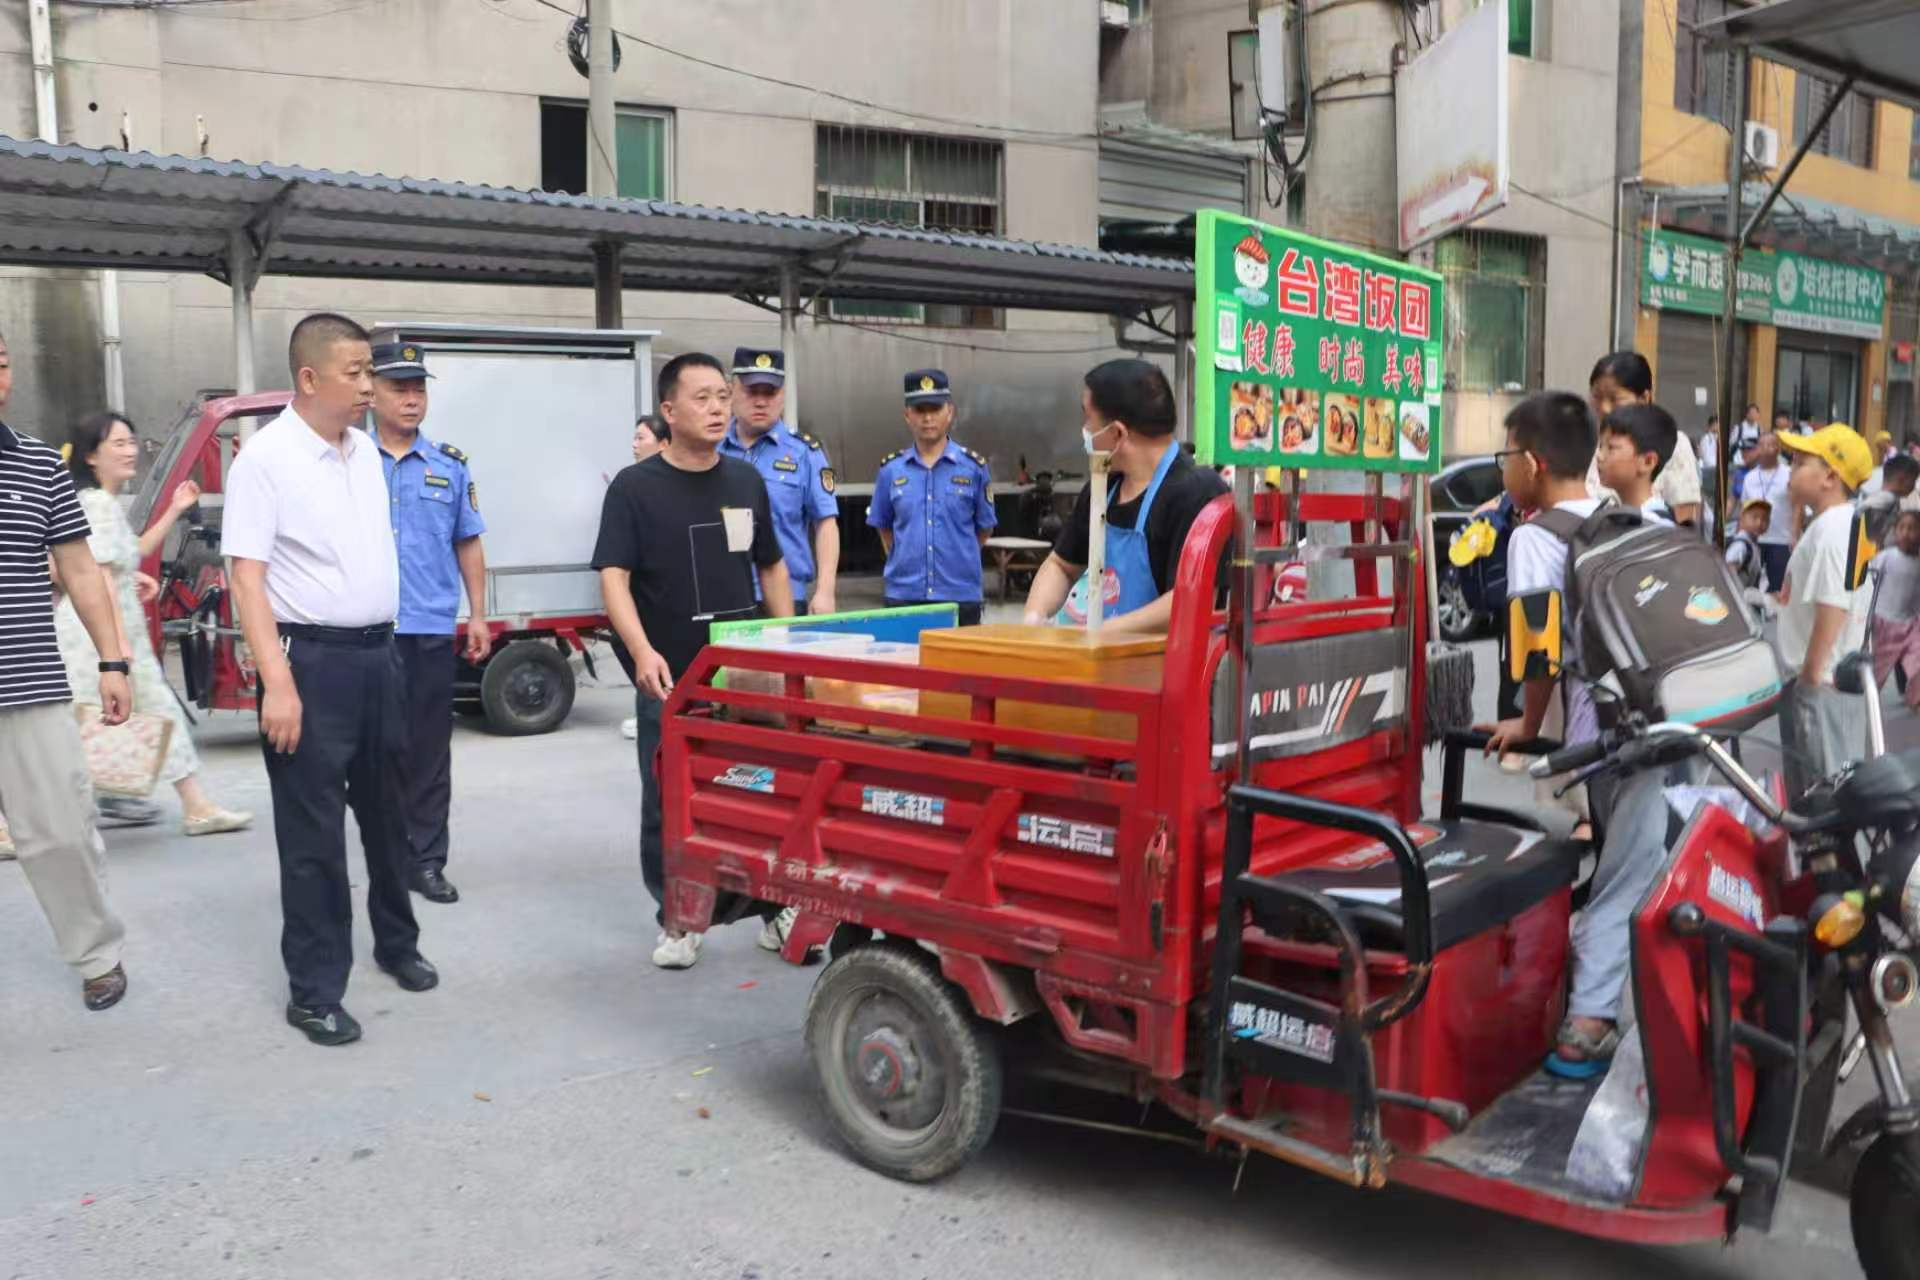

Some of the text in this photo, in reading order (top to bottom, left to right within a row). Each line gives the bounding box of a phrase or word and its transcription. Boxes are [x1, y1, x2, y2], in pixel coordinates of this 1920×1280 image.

[1278, 248, 1431, 341] 台湾饭团
[1242, 319, 1424, 396] 健康 时尚 美味
